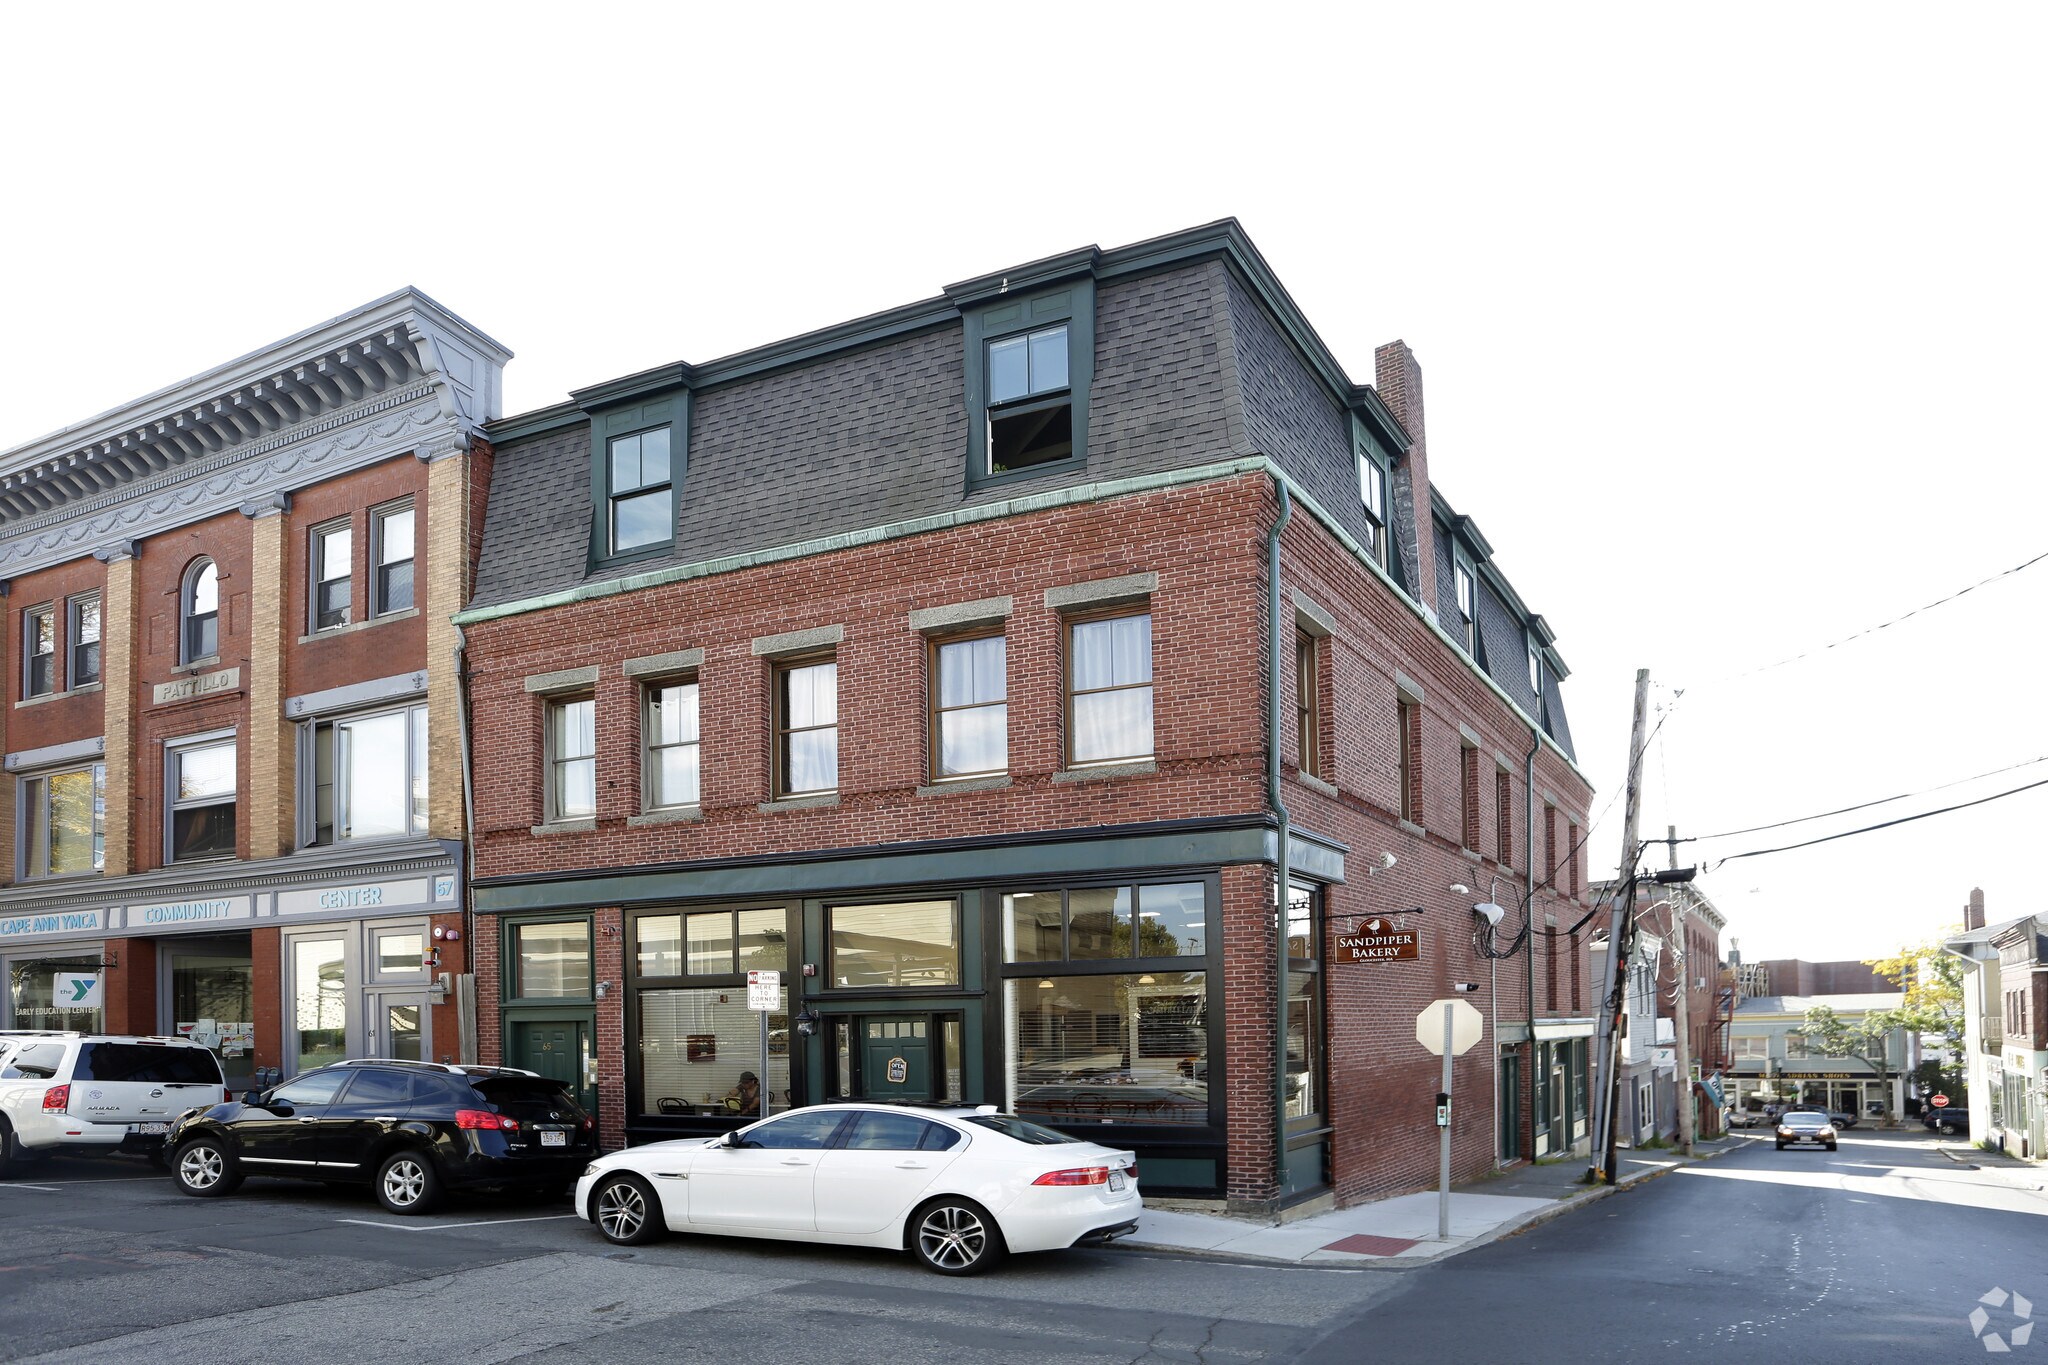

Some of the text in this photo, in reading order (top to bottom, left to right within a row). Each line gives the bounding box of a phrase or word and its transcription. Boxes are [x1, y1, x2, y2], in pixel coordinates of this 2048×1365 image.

[163, 672, 229, 700] PATTILLO
[436, 880, 453, 897] 67
[319, 886, 382, 909] CENTER
[144, 900, 231, 922] COMMUNITY
[0, 913, 98, 935] CAPE ANN YMCA
[1339, 935, 1412, 948] SANDPIPER
[1352, 947, 1400, 958] BAKERY
[749, 974, 759, 982] NO
[15, 1006, 97, 1016] EARLY EDUCATION CENTER
[542, 1042, 552, 1050] 65
